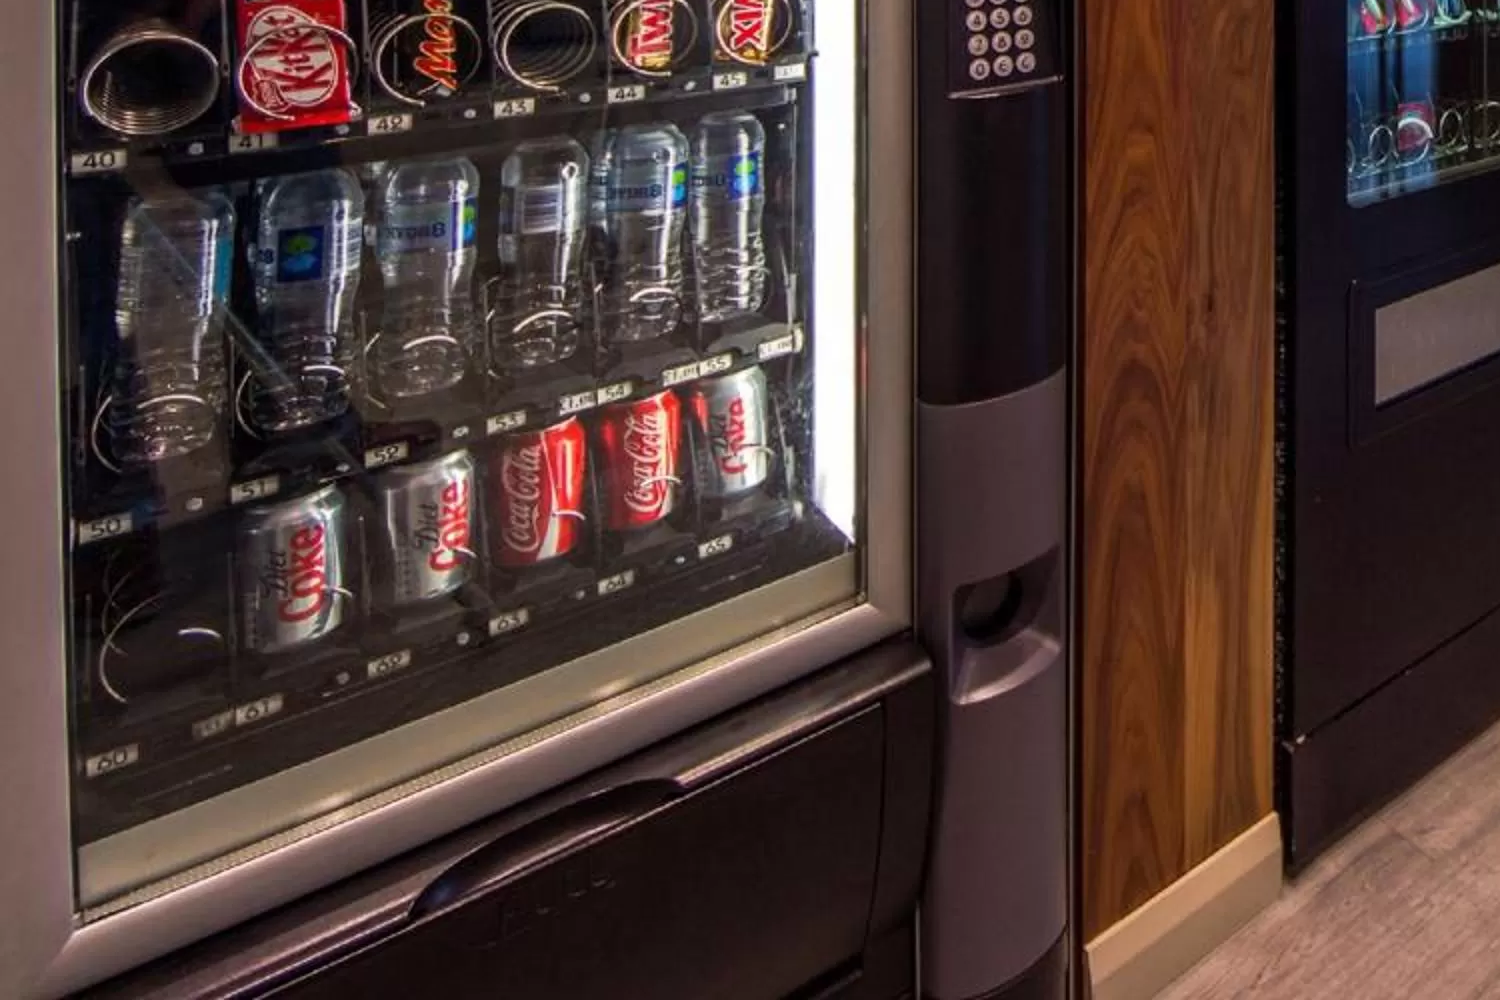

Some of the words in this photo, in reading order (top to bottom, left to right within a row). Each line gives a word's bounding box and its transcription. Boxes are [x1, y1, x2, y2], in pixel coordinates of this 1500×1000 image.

[615, 87, 637, 100] 44
[502, 100, 527, 114] 43
[376, 114, 403, 131] 42
[239, 133, 264, 149] 41
[82, 151, 115, 169] 40
[240, 480, 265, 497] 51
[91, 517, 121, 537] 50
[427, 480, 469, 571] Coke
[259, 550, 287, 598] Diet
[277, 524, 327, 622] Coke
[97, 749, 127, 770] 60
